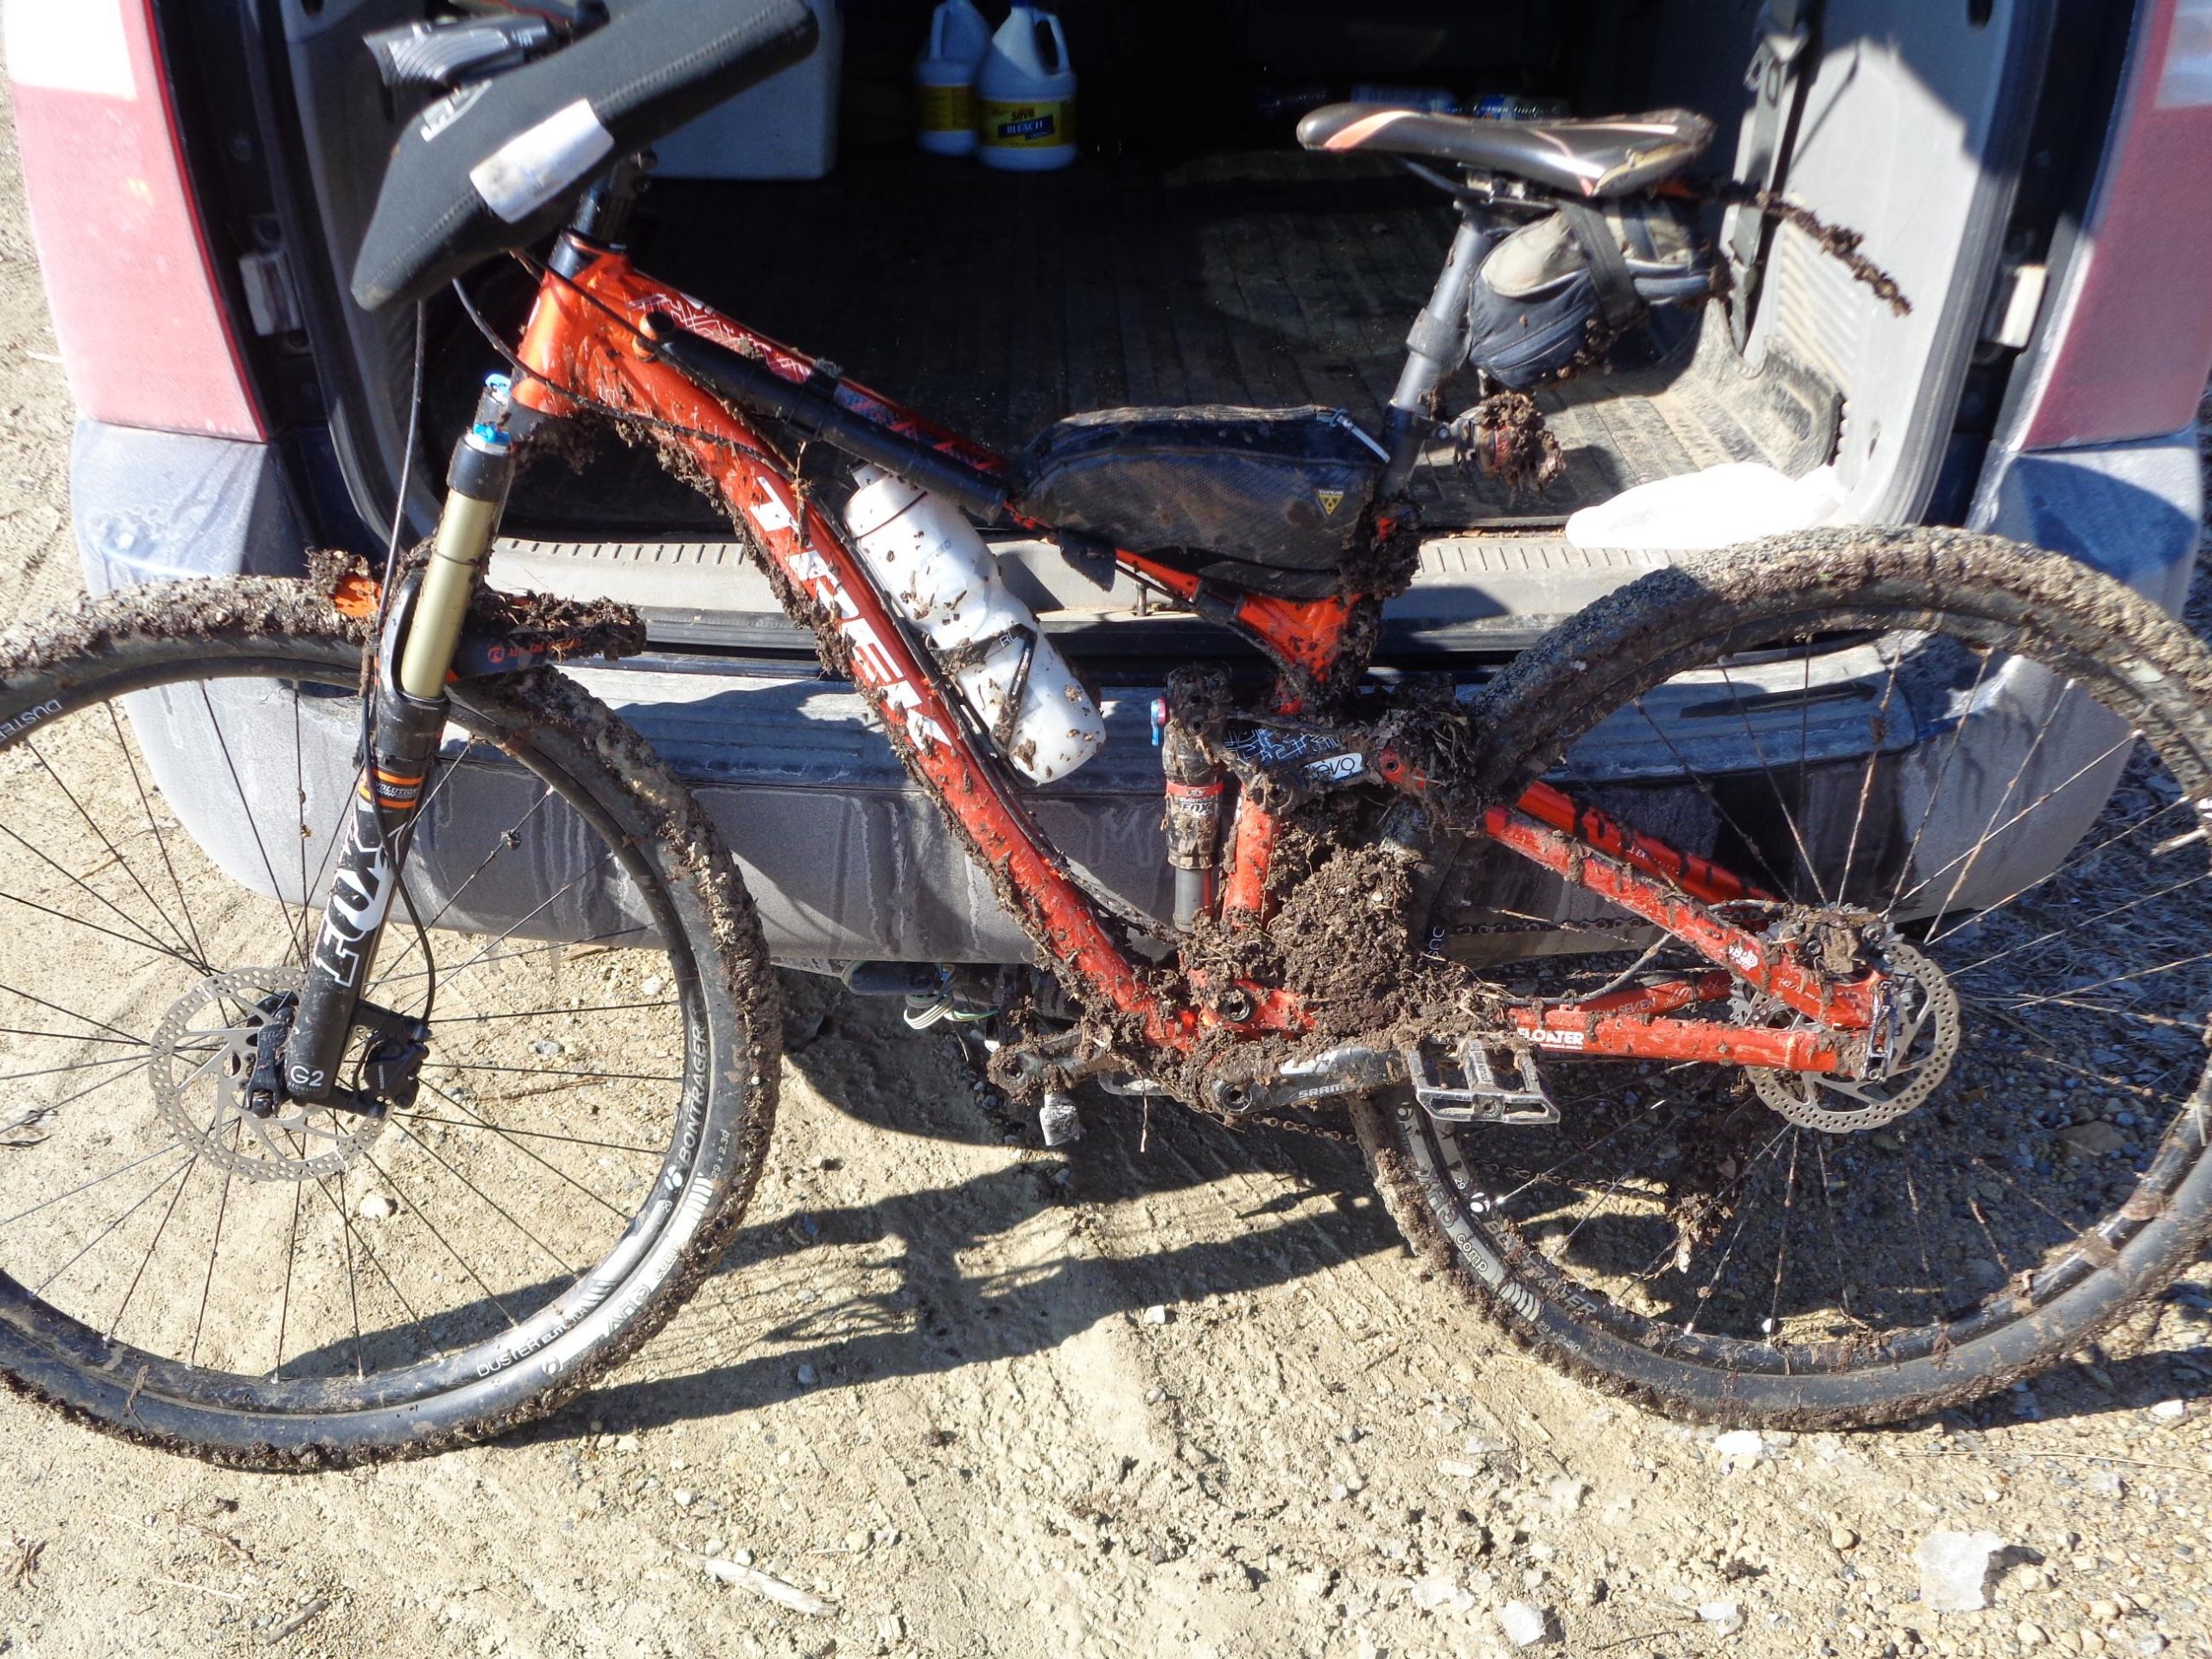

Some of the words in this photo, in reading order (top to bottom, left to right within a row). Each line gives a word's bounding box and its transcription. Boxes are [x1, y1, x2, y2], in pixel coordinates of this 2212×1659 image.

[1007, 119, 1043, 134] BLEACH
[749, 476, 953, 750] TREK
[314, 809, 401, 988] FOX
[290, 1065, 324, 1087] G2
[678, 1023, 707, 1166] BONTRAGER
[1298, 1084, 1345, 1099] SRAM
[1453, 1176, 1466, 1191] 29
[662, 1200, 673, 1213] 29
[1455, 1234, 1488, 1273] comp
[1536, 1320, 1552, 1333] 29
[476, 1338, 543, 1377] DUSTER
